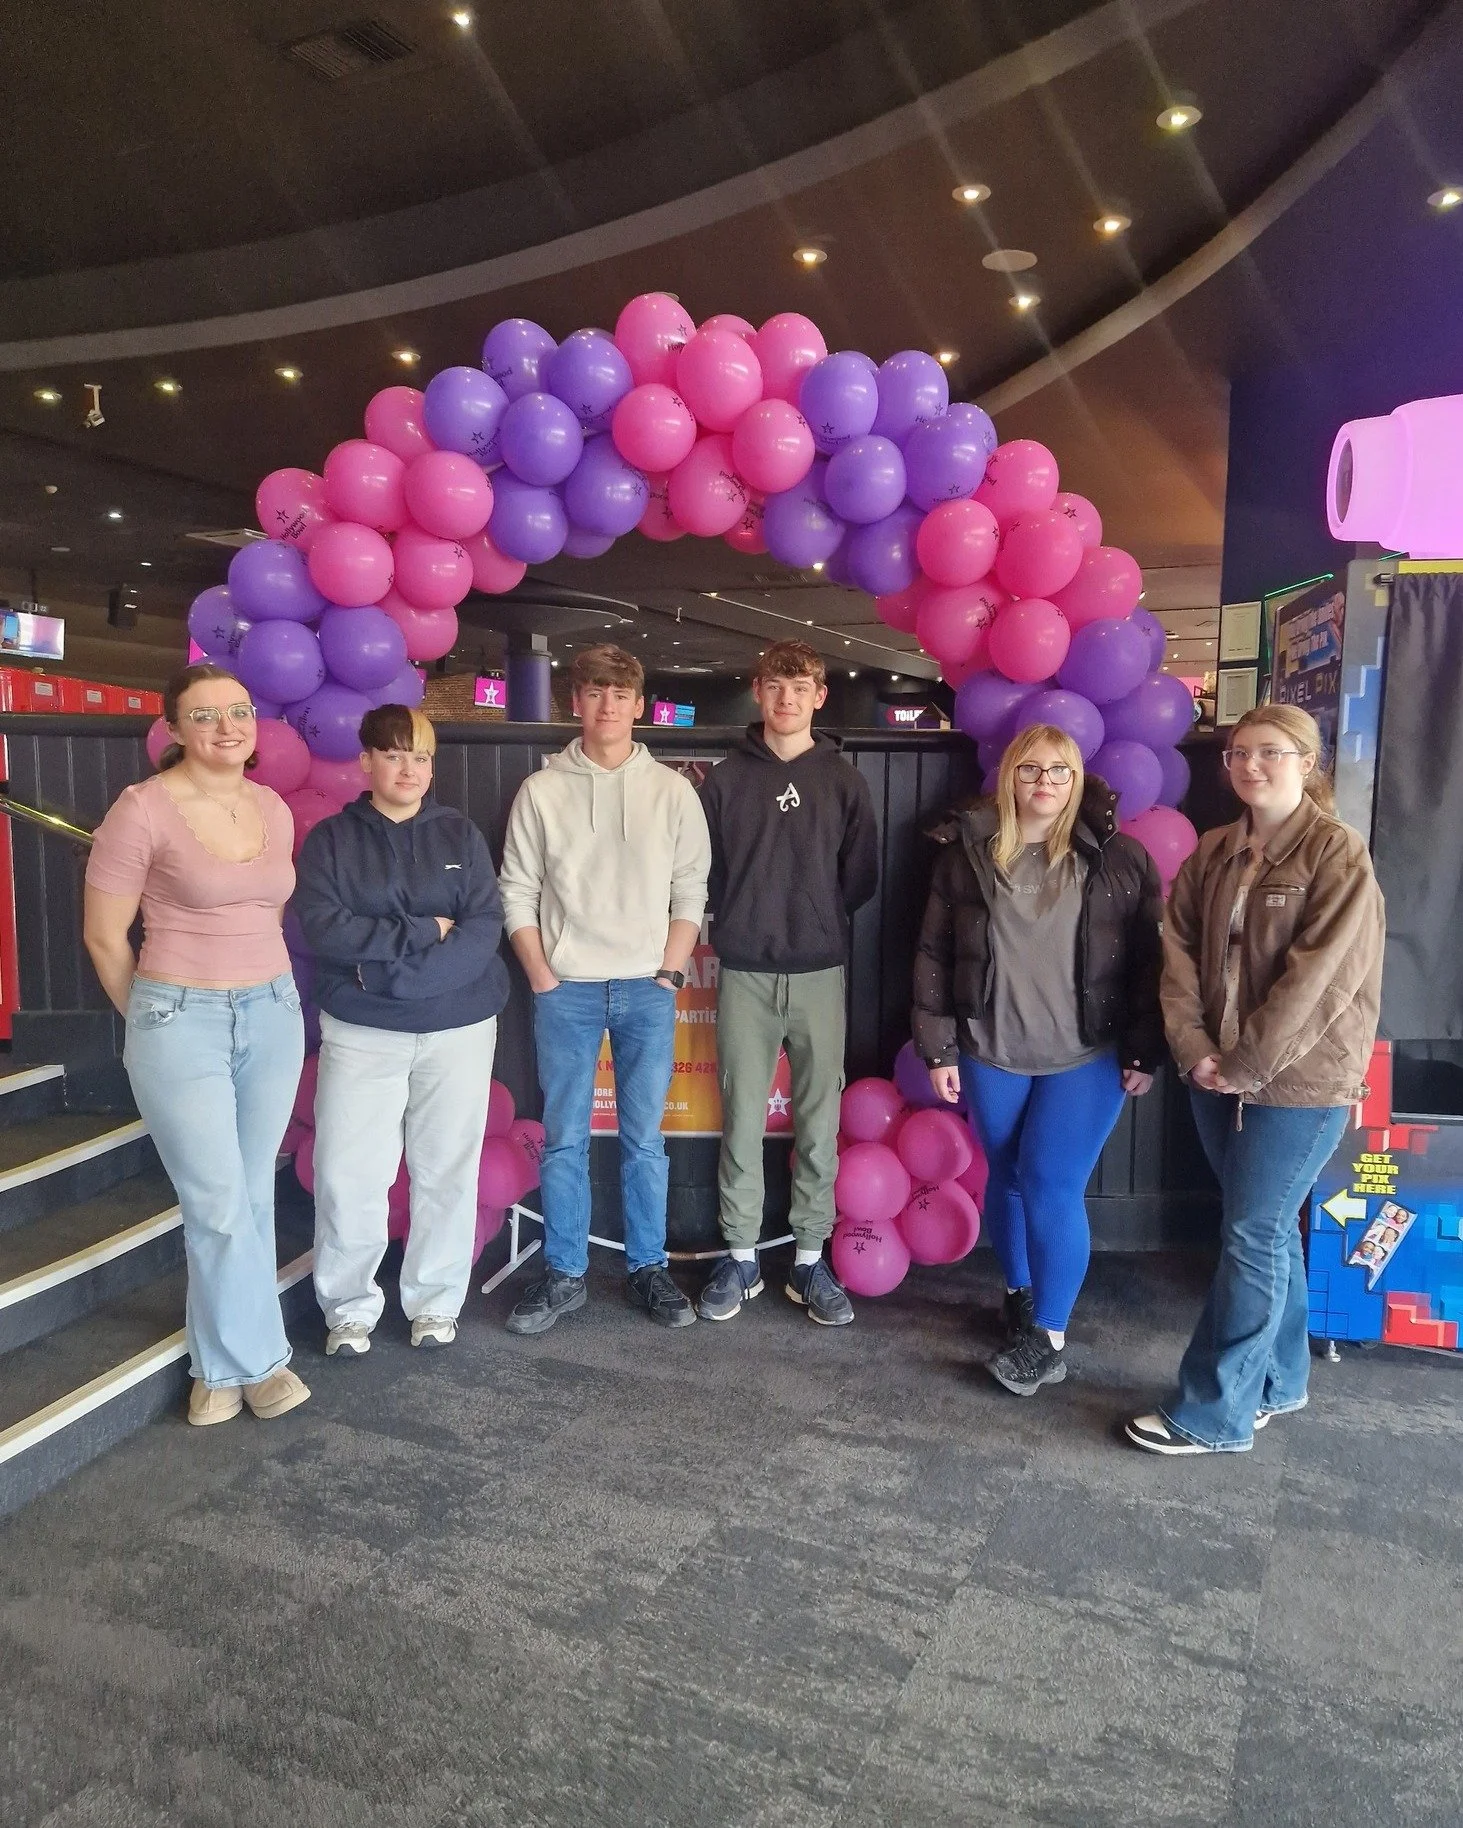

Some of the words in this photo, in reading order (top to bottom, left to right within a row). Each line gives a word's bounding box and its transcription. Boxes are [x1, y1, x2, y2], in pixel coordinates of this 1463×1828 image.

[290, 521, 308, 540] Bowl
[683, 956, 720, 988] AR
[1360, 1153, 1393, 1164] GET
[1352, 1163, 1399, 1175] YOUR
[1361, 1174, 1390, 1184] PIX
[1353, 1183, 1397, 1194] HERE
[853, 1226, 873, 1234] Bowl
[842, 1232, 883, 1243] Hollywood
